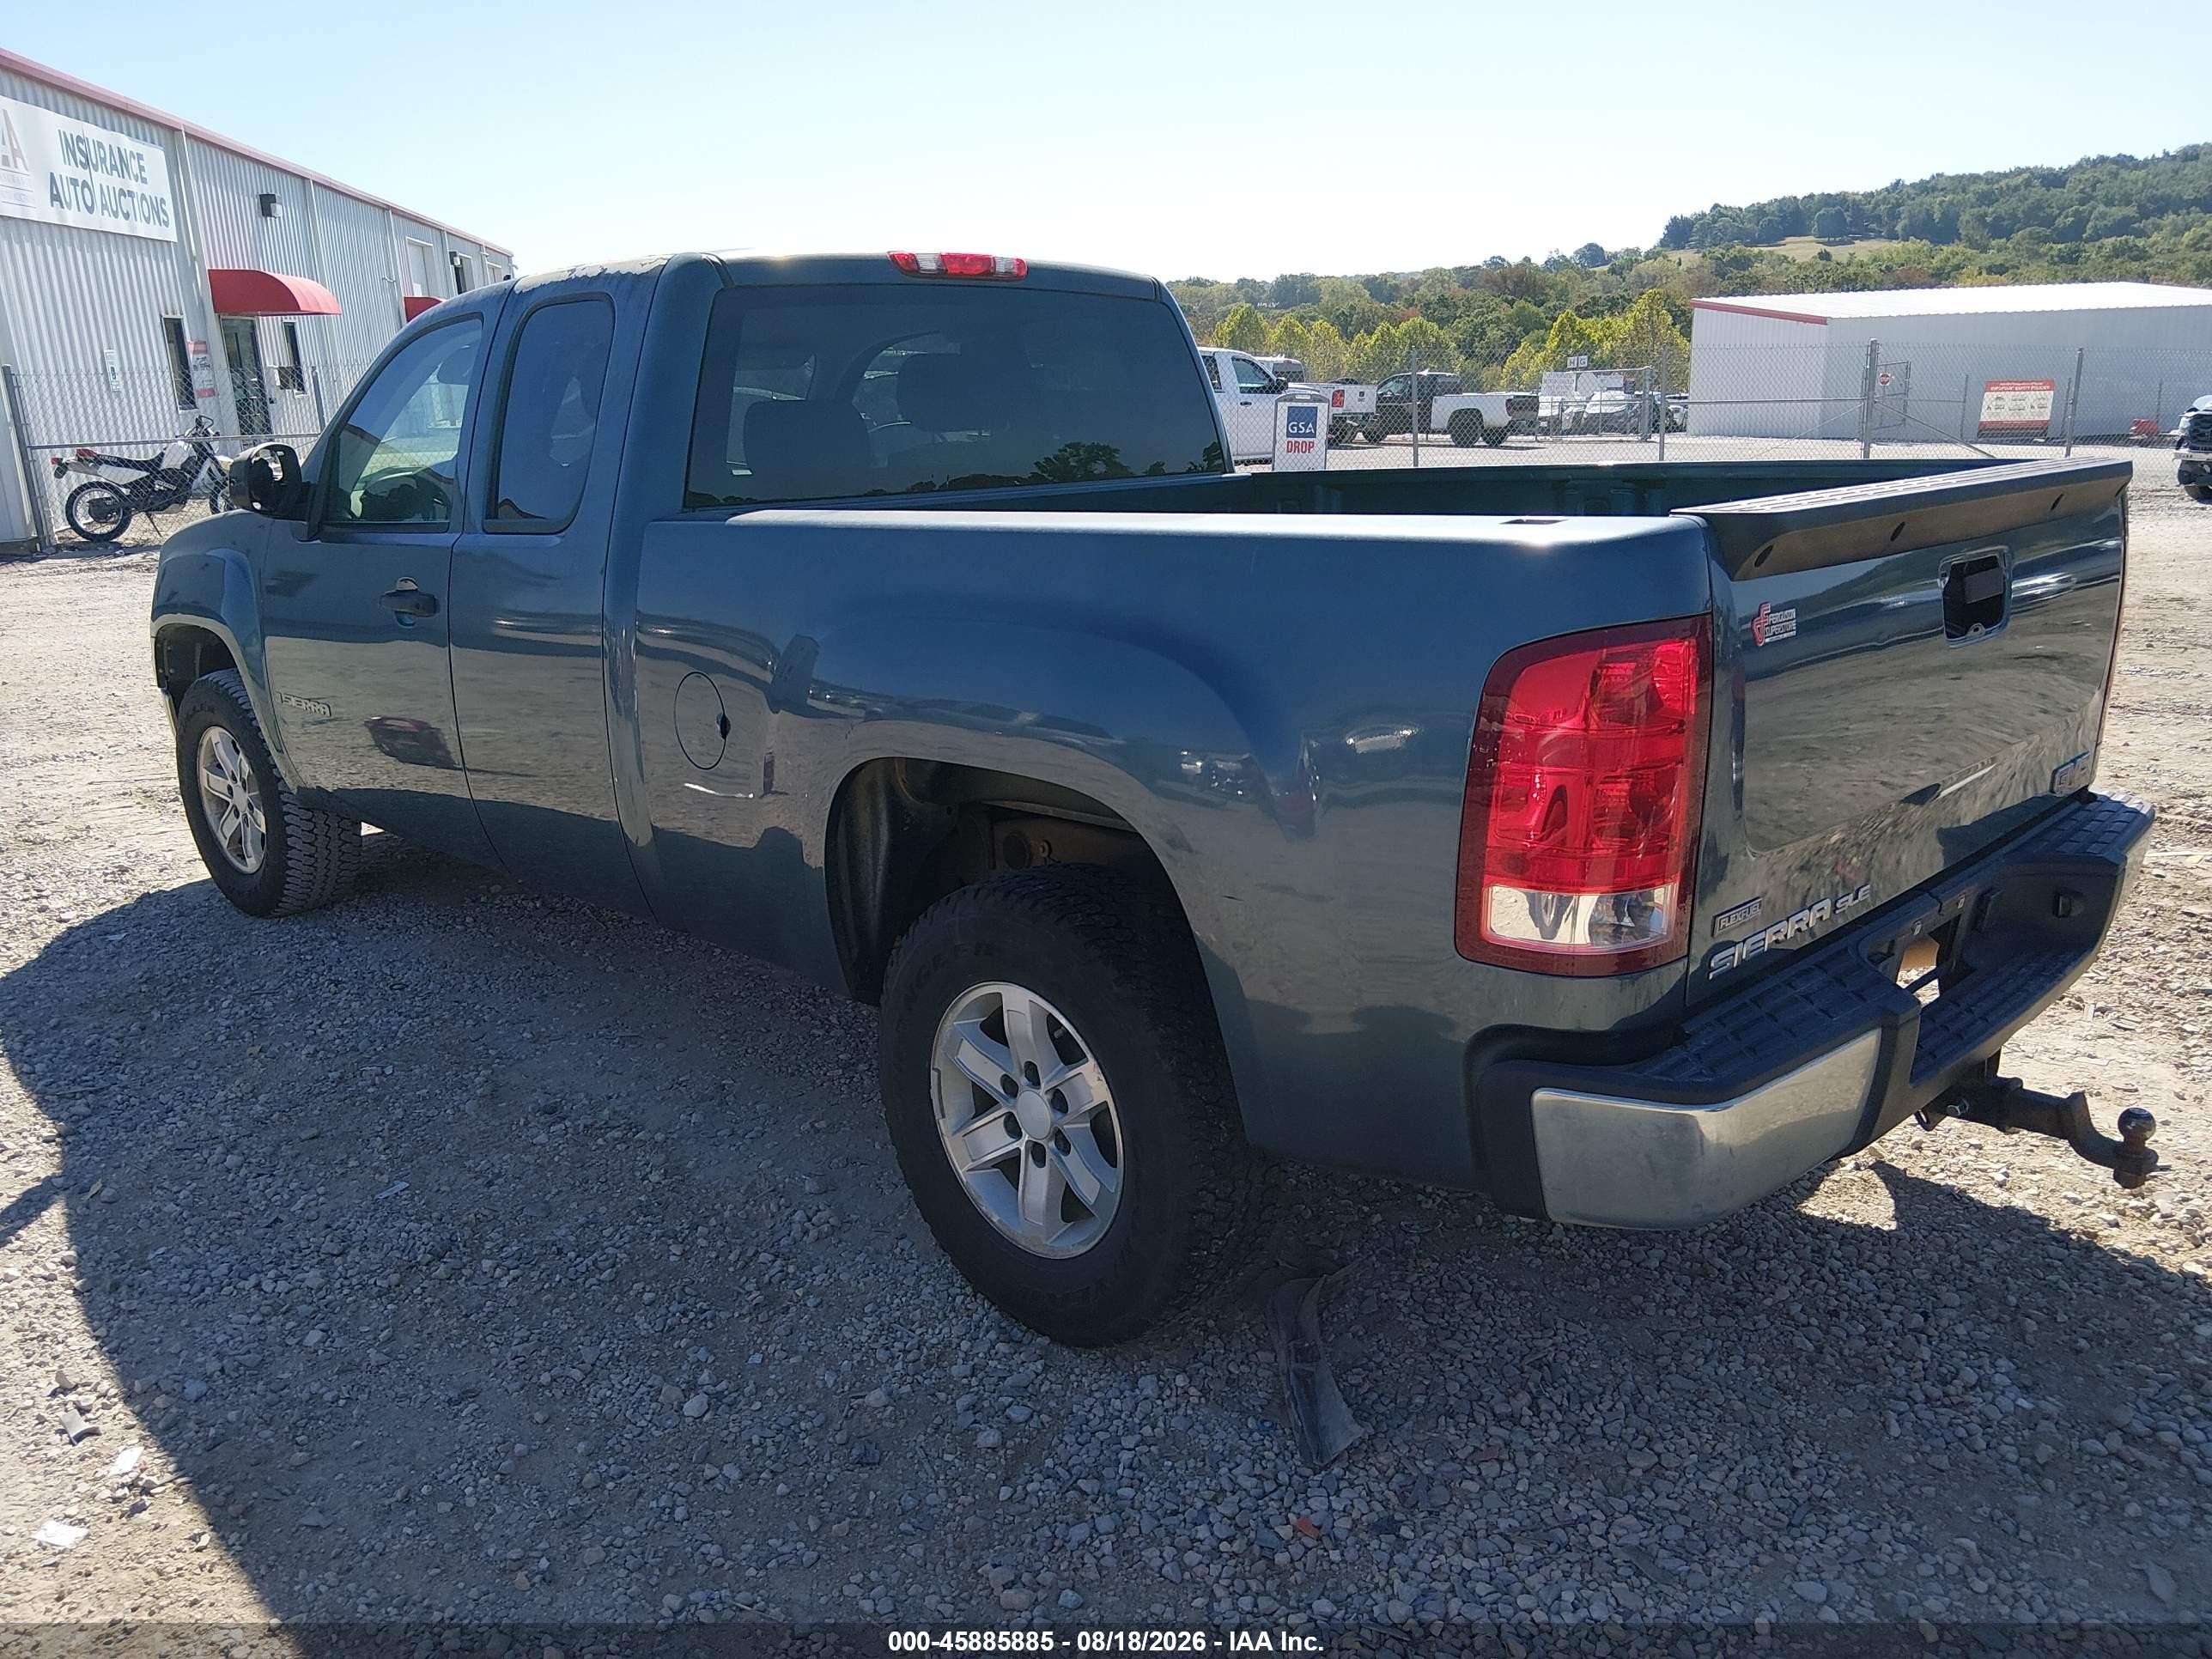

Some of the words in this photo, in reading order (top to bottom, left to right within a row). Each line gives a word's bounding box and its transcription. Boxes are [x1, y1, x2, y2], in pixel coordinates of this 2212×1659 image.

[58, 129, 149, 185] INSURANCE
[49, 172, 96, 215] AUTO
[99, 183, 170, 228] AUCTIONS
[1288, 422, 1316, 434] GSA
[1286, 440, 1316, 454] DROP
[283, 693, 331, 717] SIERRA
[1719, 902, 1762, 929] FLEXFUEL
[1708, 897, 1832, 981] SIERRA
[1835, 884, 1870, 915] SLE
